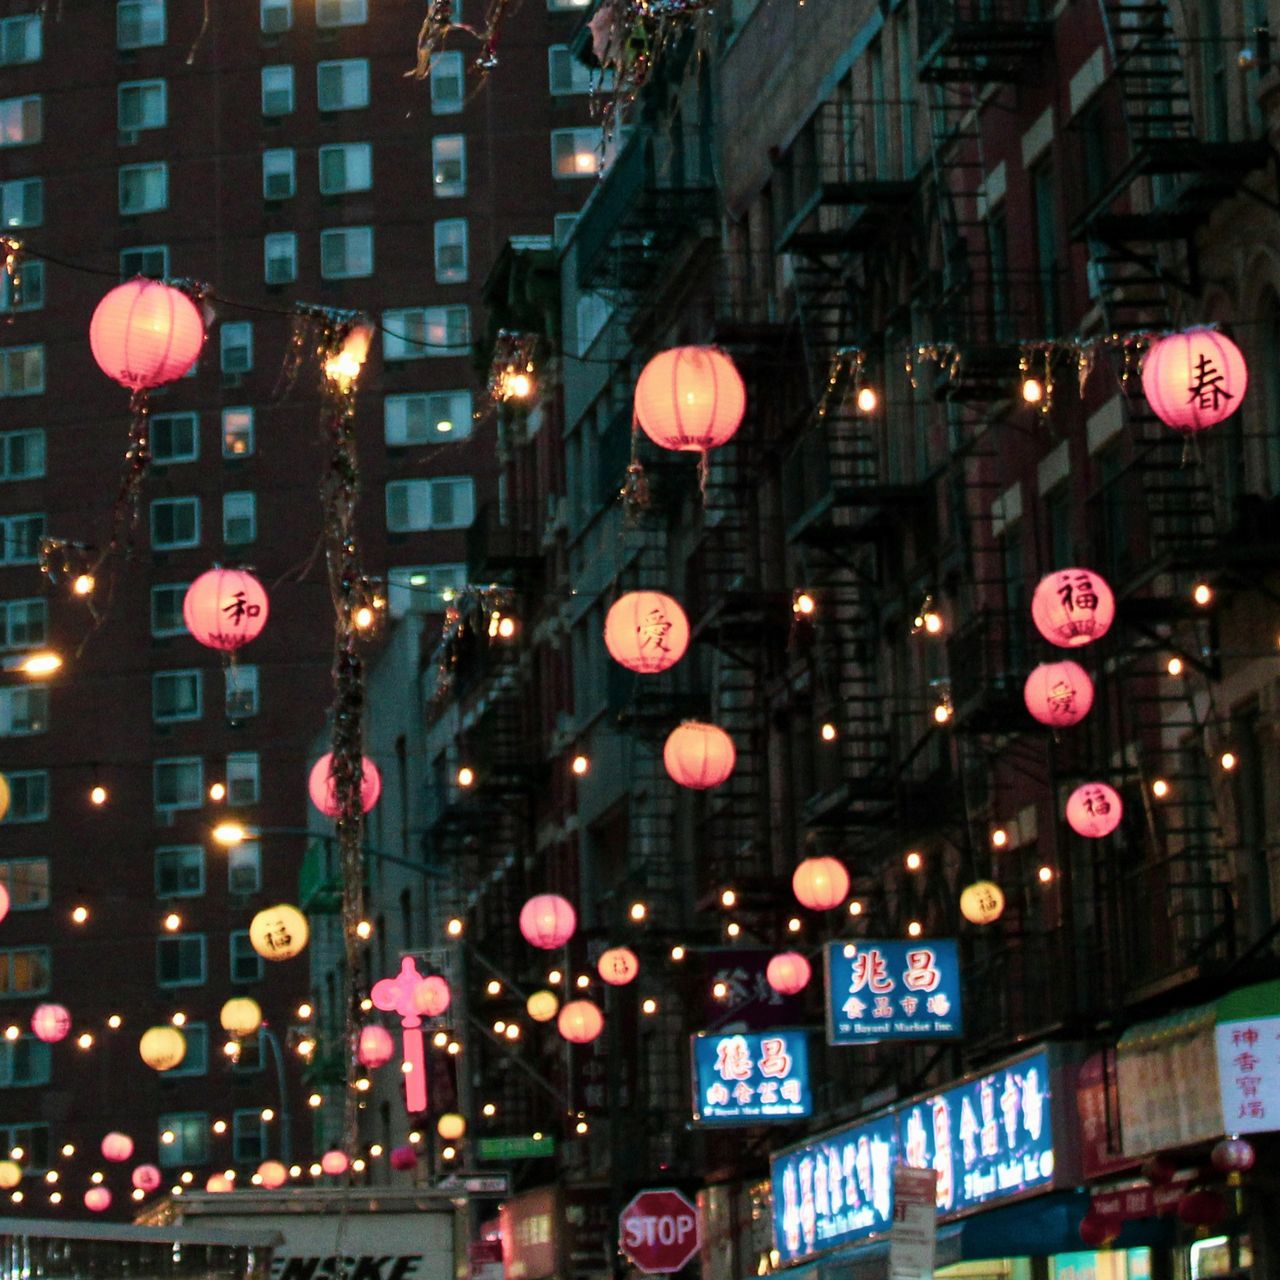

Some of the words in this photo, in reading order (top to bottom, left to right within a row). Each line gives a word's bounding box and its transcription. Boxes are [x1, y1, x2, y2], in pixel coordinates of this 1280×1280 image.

[1187, 355, 1233, 410] 春
[222, 592, 260, 626] 和
[1057, 575, 1098, 613] 福
[1083, 789, 1110, 817] 福
[849, 949, 941, 994] 兆昌
[625, 1215, 694, 1248] STOP
